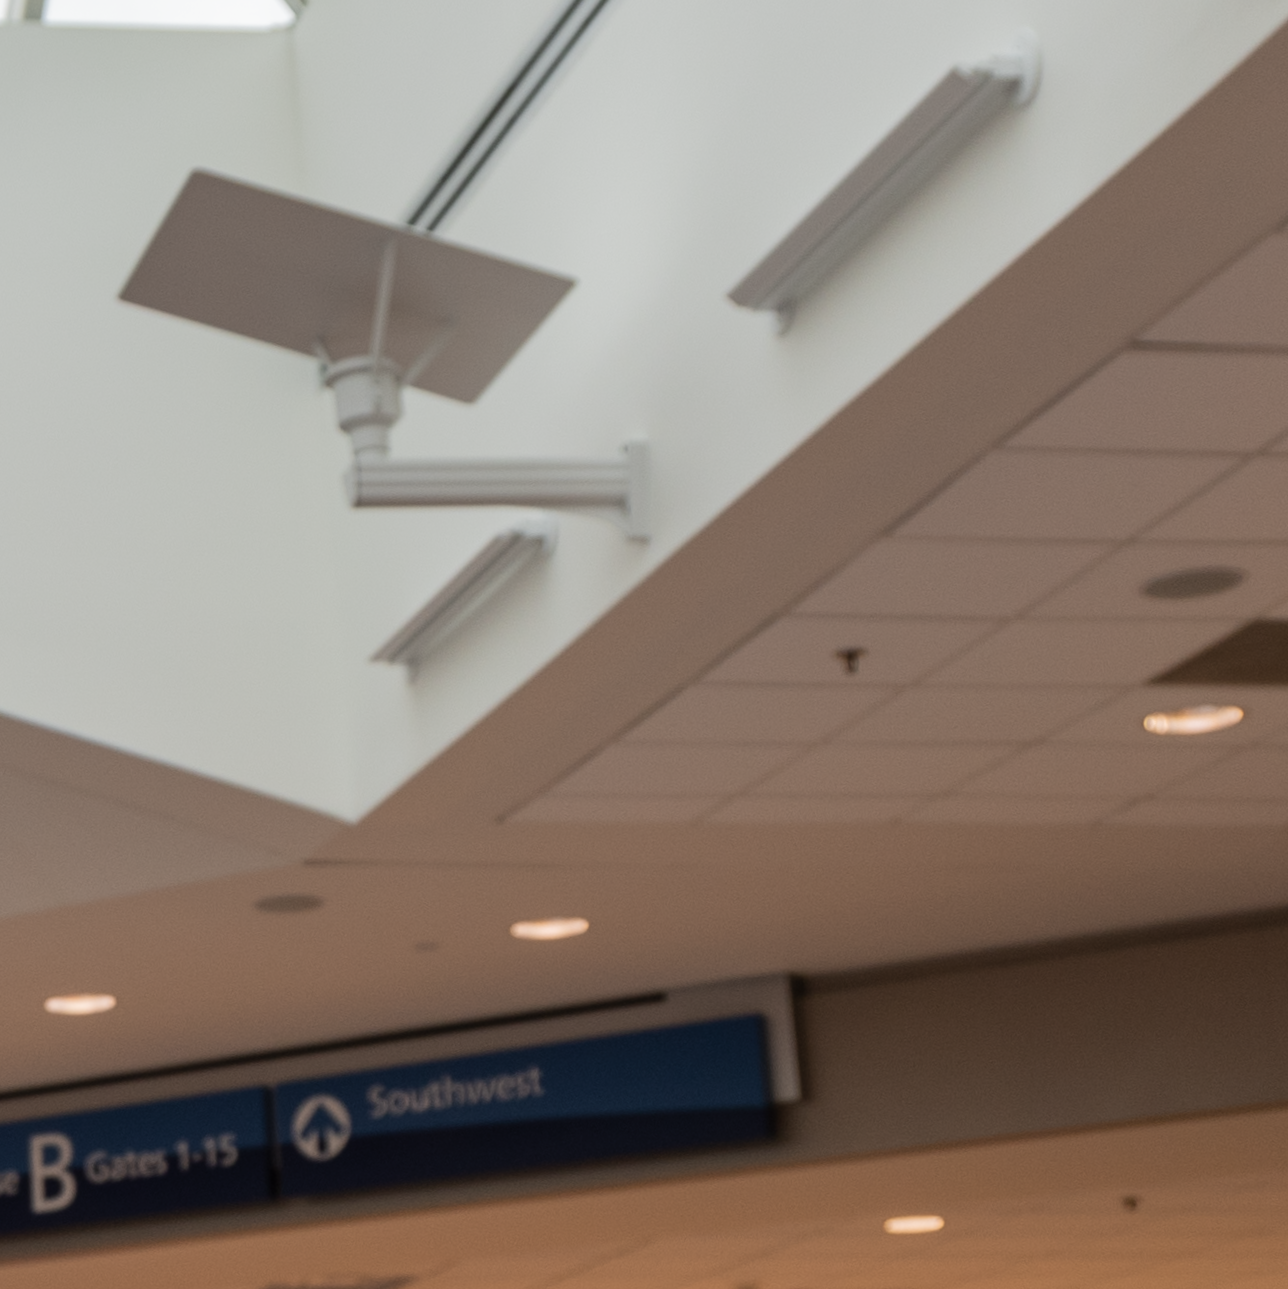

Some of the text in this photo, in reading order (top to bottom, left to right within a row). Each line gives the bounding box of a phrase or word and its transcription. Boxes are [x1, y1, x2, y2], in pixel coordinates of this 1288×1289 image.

[367, 1067, 544, 1118] Southwest
[28, 1132, 77, 1213] B
[85, 1145, 168, 1185] Gates
[175, 1134, 238, 1171] 1-15
